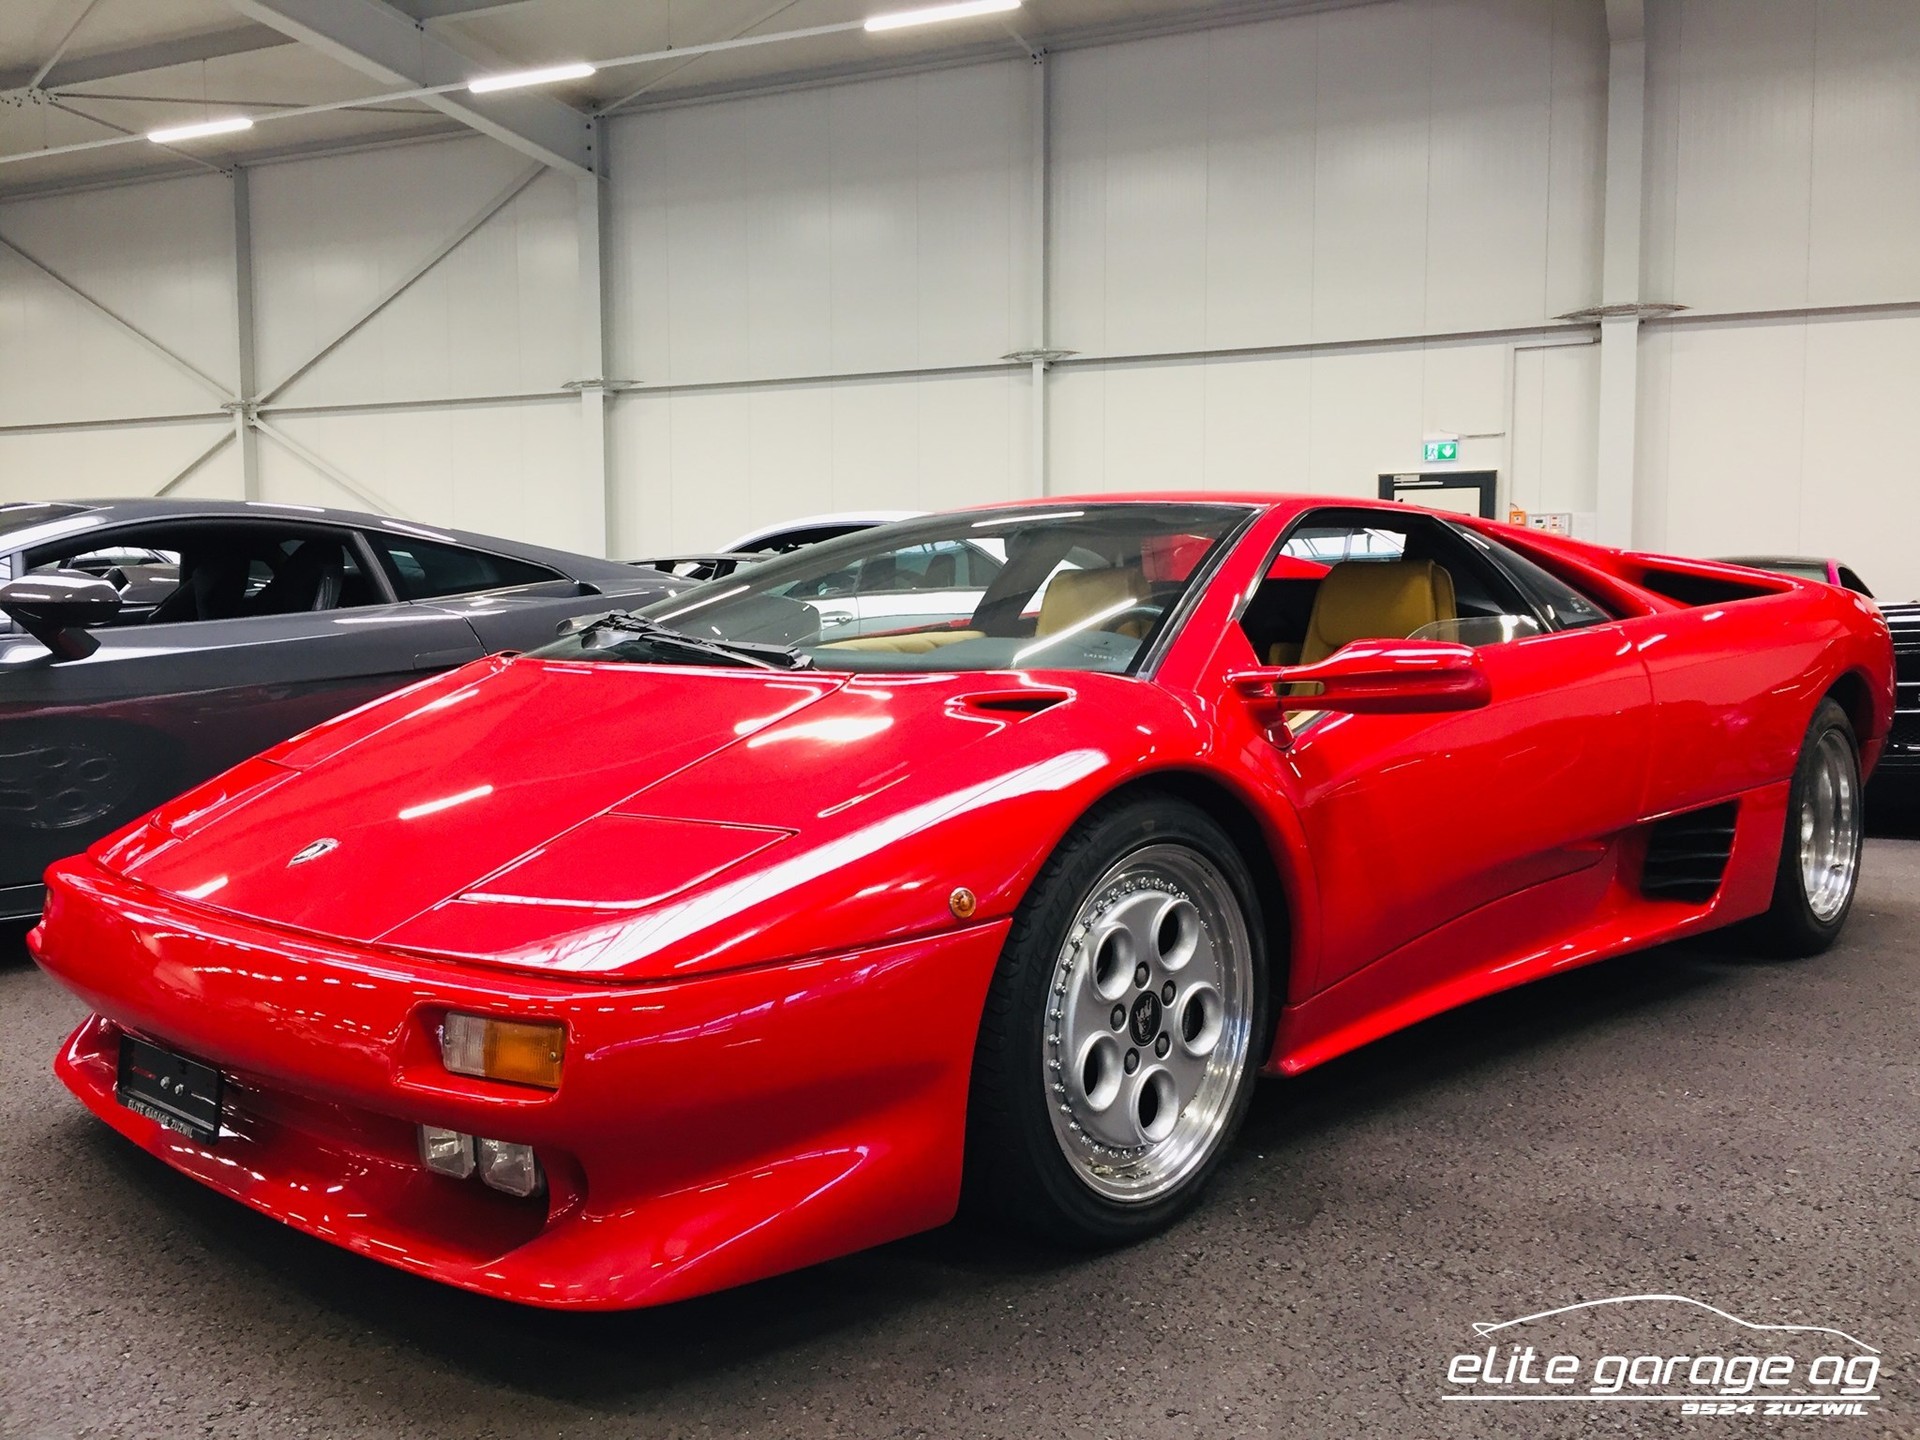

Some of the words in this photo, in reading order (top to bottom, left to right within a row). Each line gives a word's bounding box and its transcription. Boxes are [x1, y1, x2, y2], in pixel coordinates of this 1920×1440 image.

[128, 1099, 145, 1115] ELITE
[145, 1106, 170, 1127] GARAGE
[170, 1119, 194, 1139] ZUZWIL
